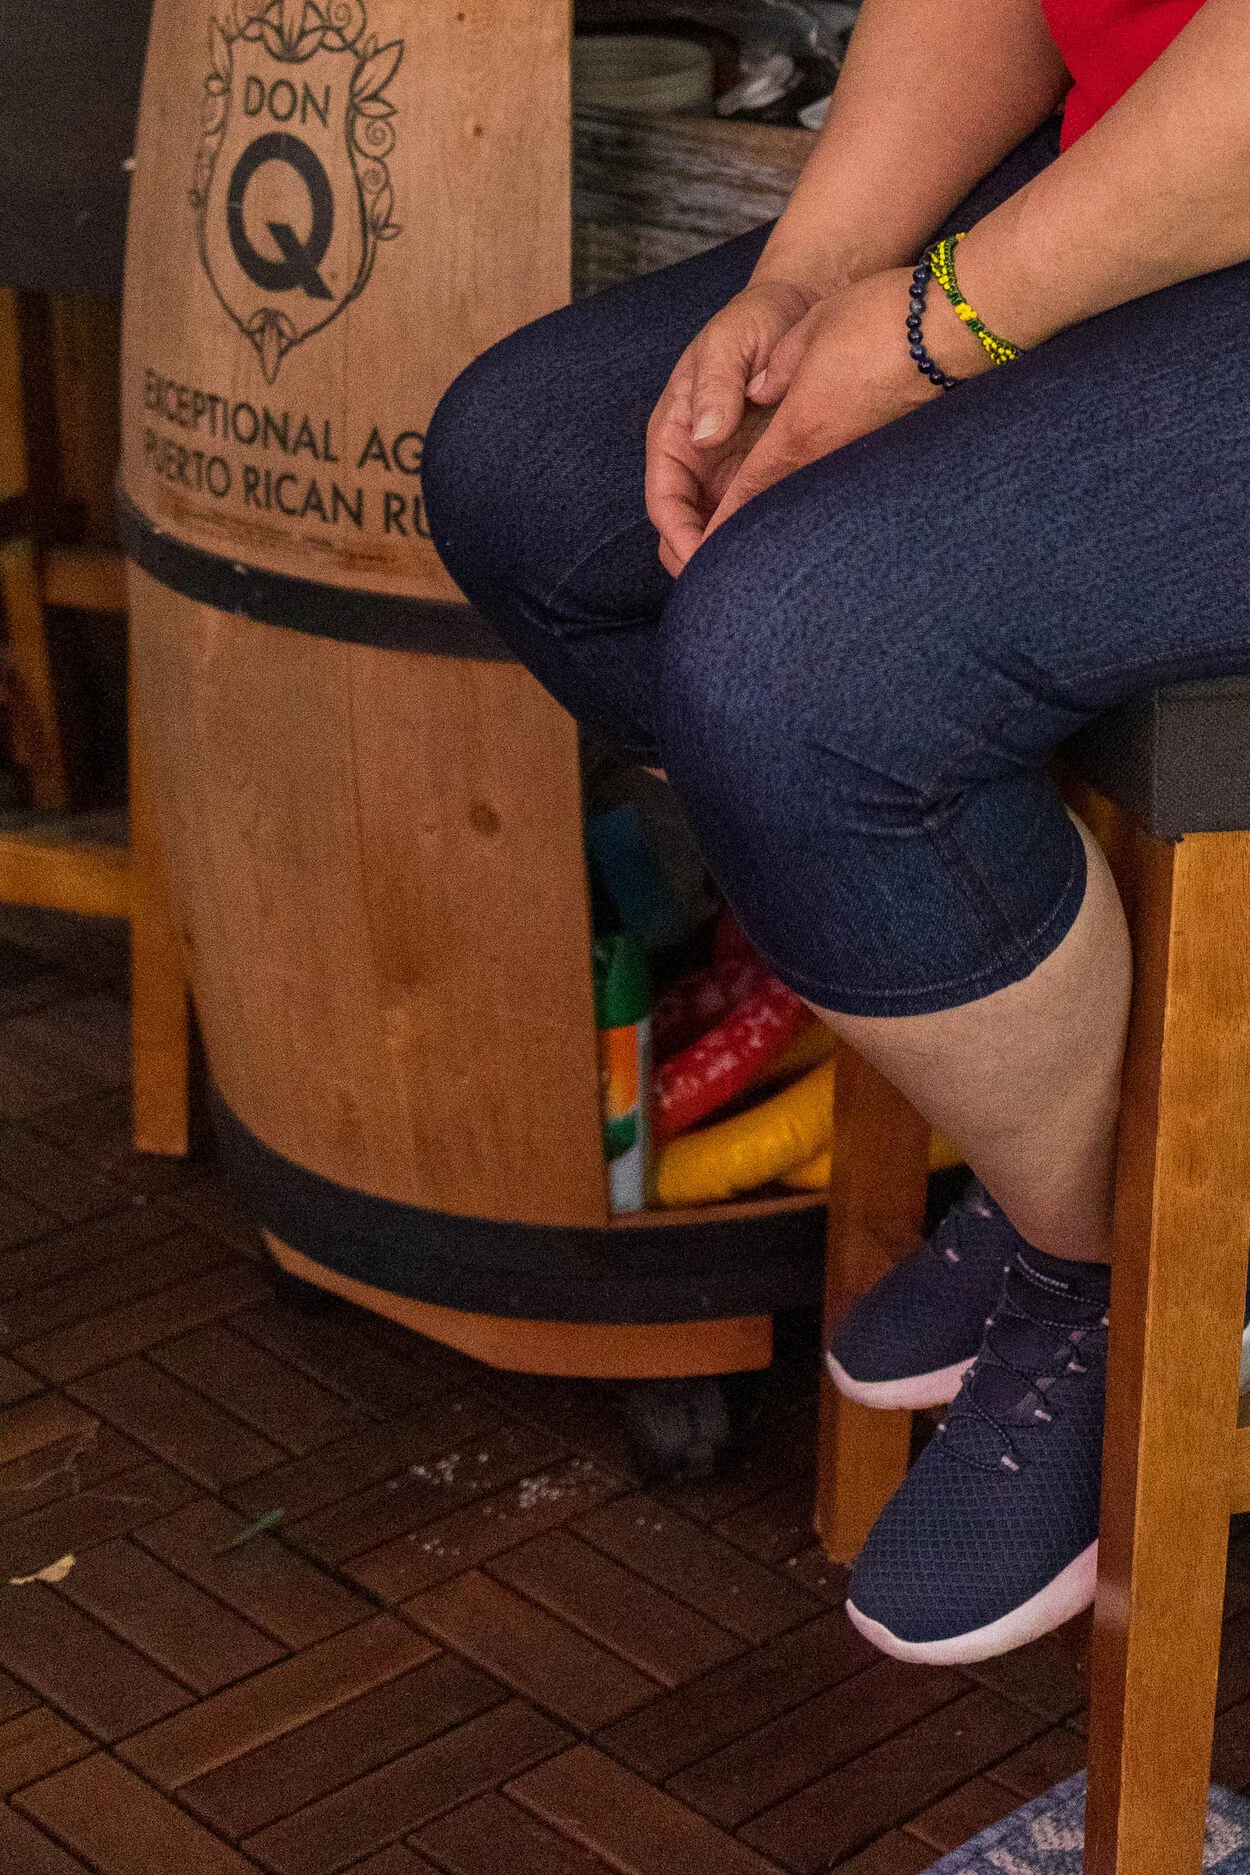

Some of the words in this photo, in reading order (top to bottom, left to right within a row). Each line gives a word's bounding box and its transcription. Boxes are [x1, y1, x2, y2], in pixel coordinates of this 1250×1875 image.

[243, 75, 331, 127] DON
[227, 132, 335, 301] Q
[145, 367, 338, 463] EXCEPTIONAL
[145, 426, 232, 498] PUERTO
[244, 464, 365, 530] RICAN
